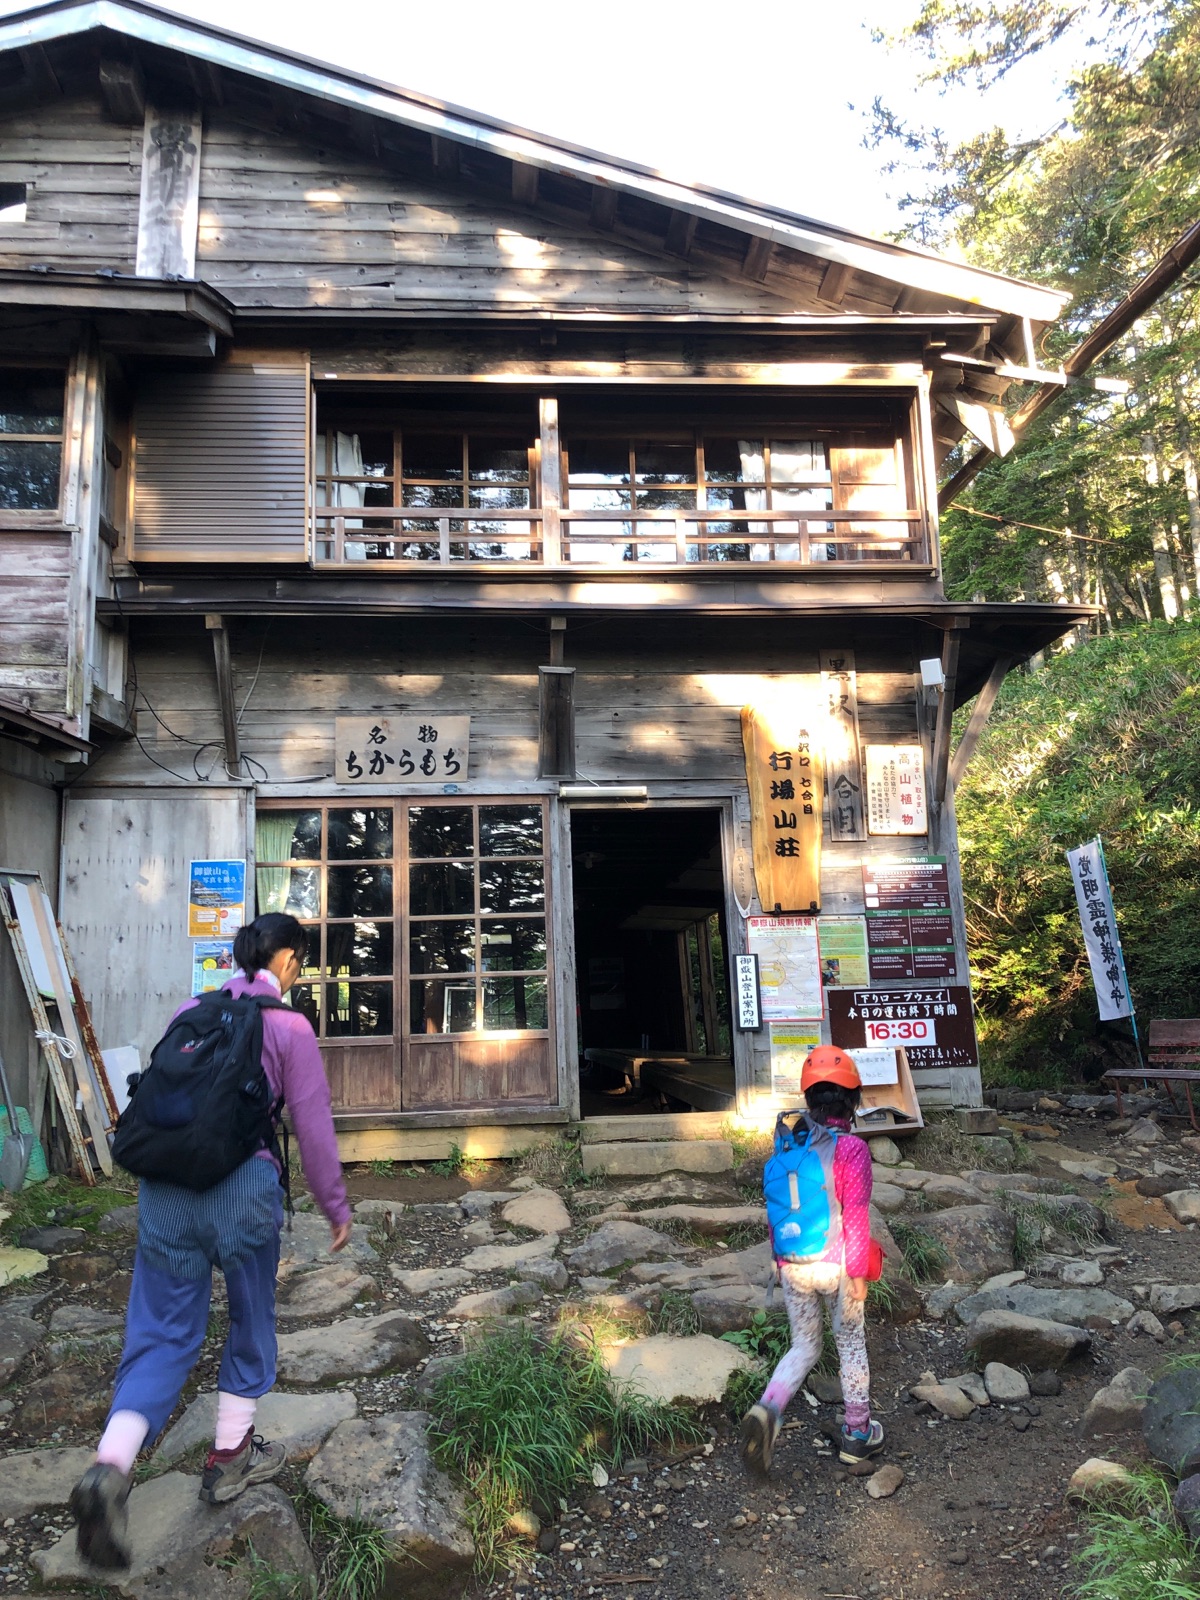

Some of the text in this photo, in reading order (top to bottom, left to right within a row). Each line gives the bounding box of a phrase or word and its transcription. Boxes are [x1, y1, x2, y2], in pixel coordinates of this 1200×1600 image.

[367, 725, 438, 745] 名物
[345, 747, 461, 779] ちからもち
[899, 753, 913, 825] 高山植物
[768, 751, 800, 857] 行場山荘
[740, 957, 754, 1026] 御嶽山登山案内所
[860, 992, 943, 1004] 下りロープウェイ
[847, 1003, 958, 1020] 本日の運転終了時間
[867, 1021, 928, 1040] 16:30
